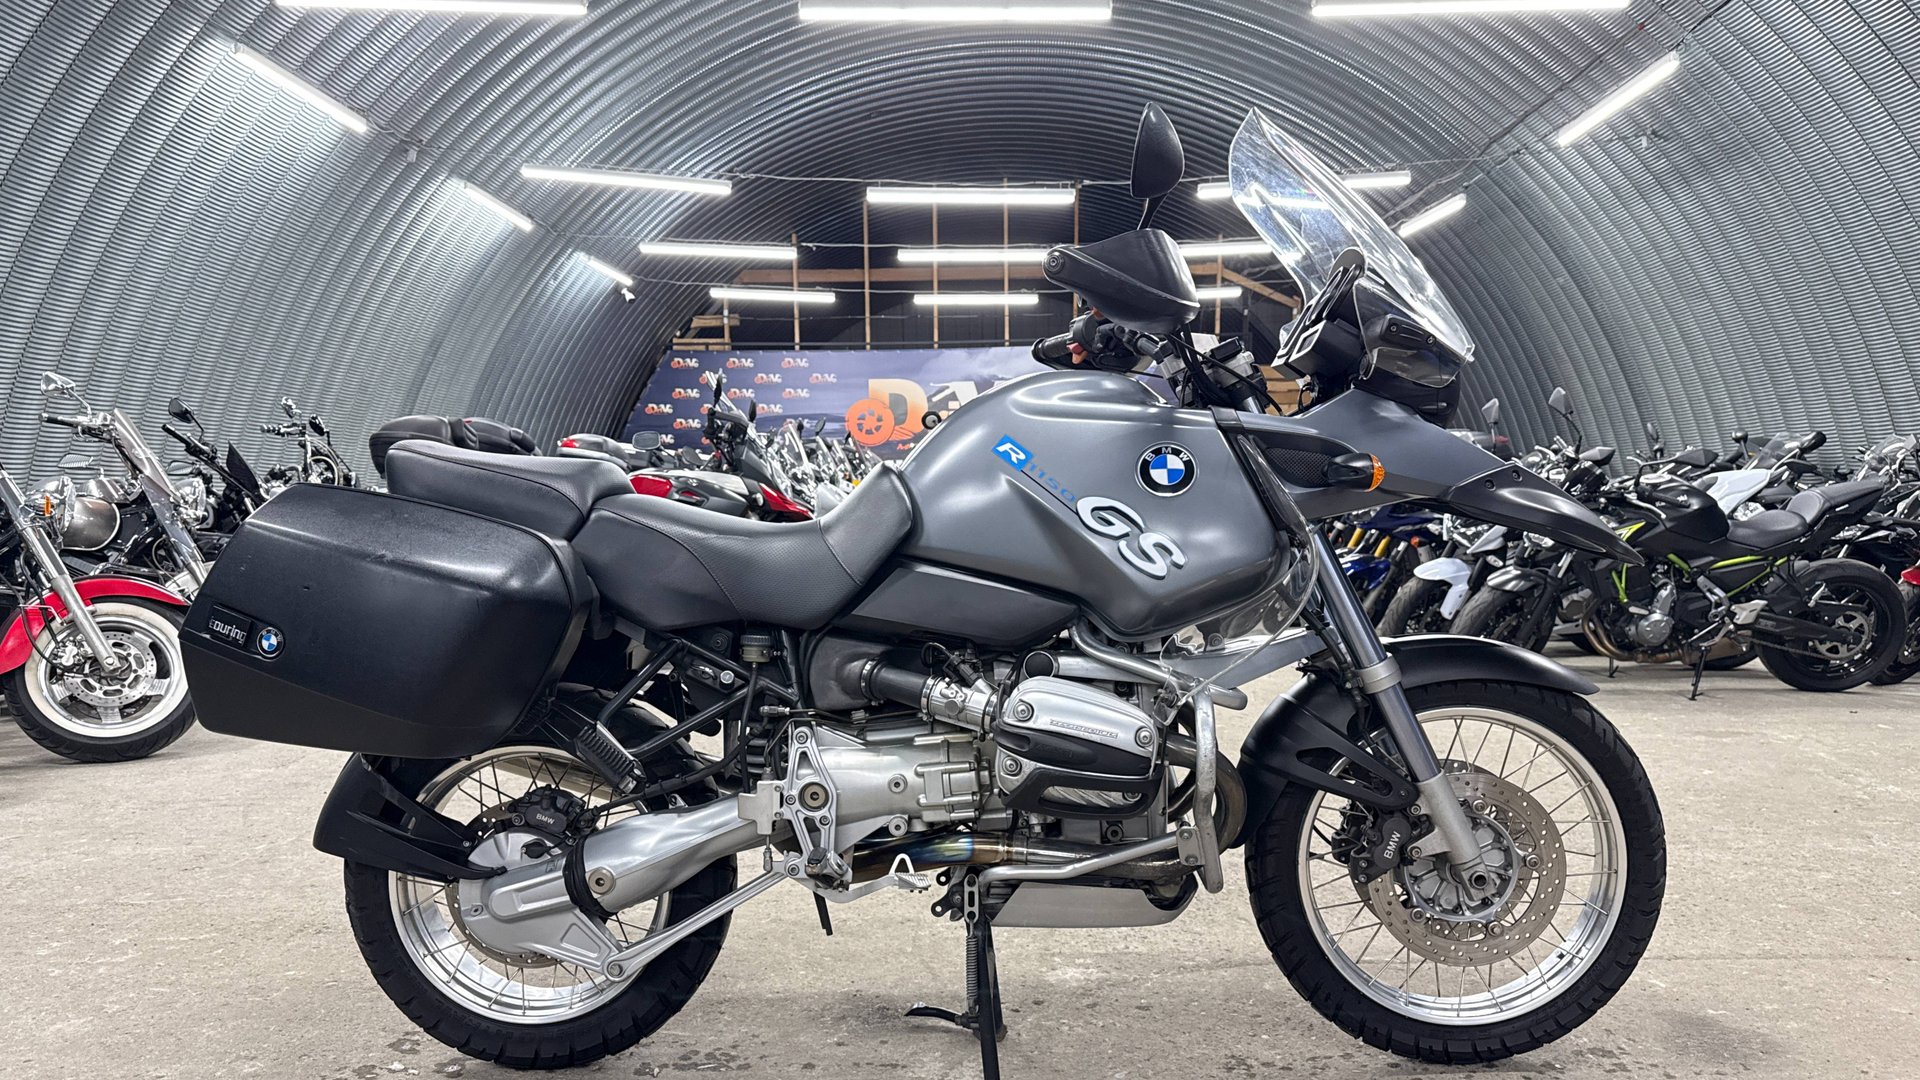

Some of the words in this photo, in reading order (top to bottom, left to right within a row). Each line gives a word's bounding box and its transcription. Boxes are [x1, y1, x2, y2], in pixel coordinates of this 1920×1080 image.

[1144, 447, 1190, 463] BMW
[1028, 463, 1076, 503] 1150
[1076, 497, 1186, 581] GS
[536, 813, 555, 825] BMW
[1383, 830, 1401, 859] BMW
